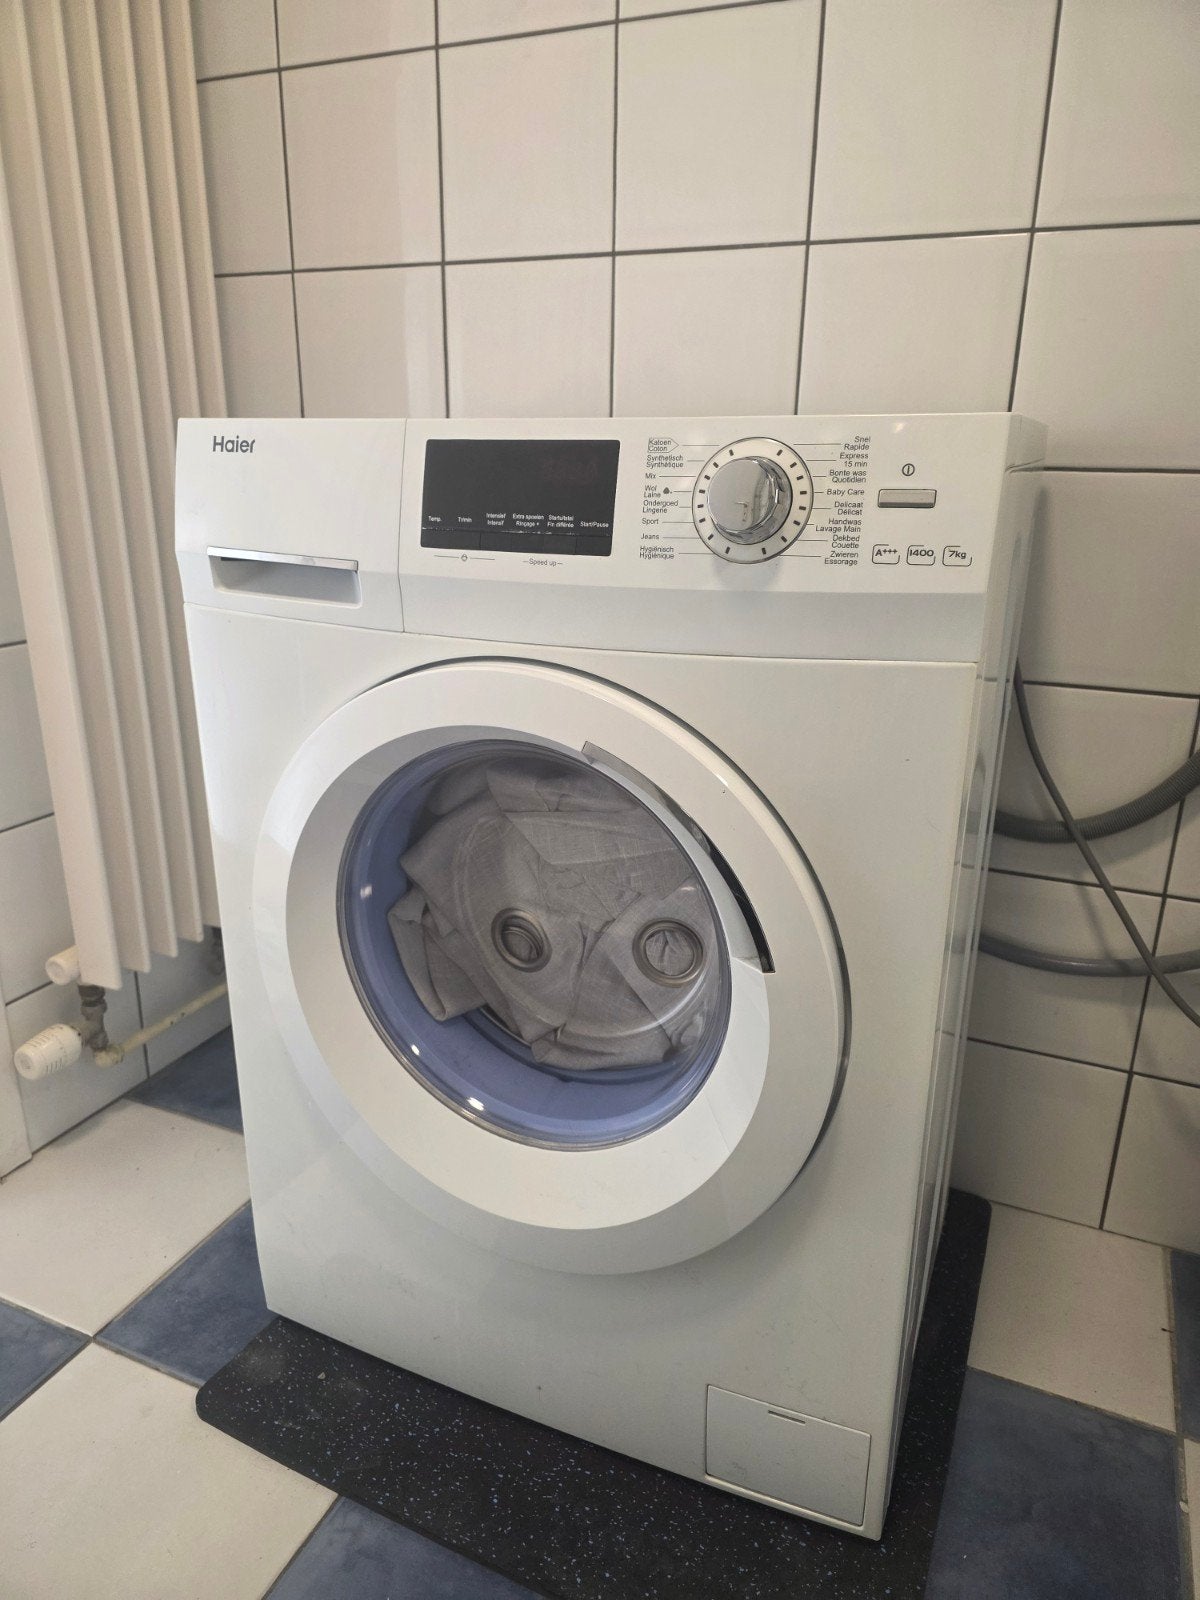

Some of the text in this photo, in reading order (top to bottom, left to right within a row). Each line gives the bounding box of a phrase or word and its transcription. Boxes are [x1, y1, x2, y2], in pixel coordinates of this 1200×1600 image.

[212, 434, 256, 453] Haier
[649, 438, 672, 446] Katoen
[844, 443, 870, 451] Rapide
[647, 454, 684, 462] Synthetisch
[840, 452, 869, 460] Express
[832, 476, 866, 484] Quotidien
[838, 508, 862, 516] Délicat
[875, 548, 898, 557] A+++
[909, 549, 934, 557] 1400
[948, 550, 967, 559] 7kg
[529, 558, 547, 566] Speed
[824, 558, 858, 566] Essorage
